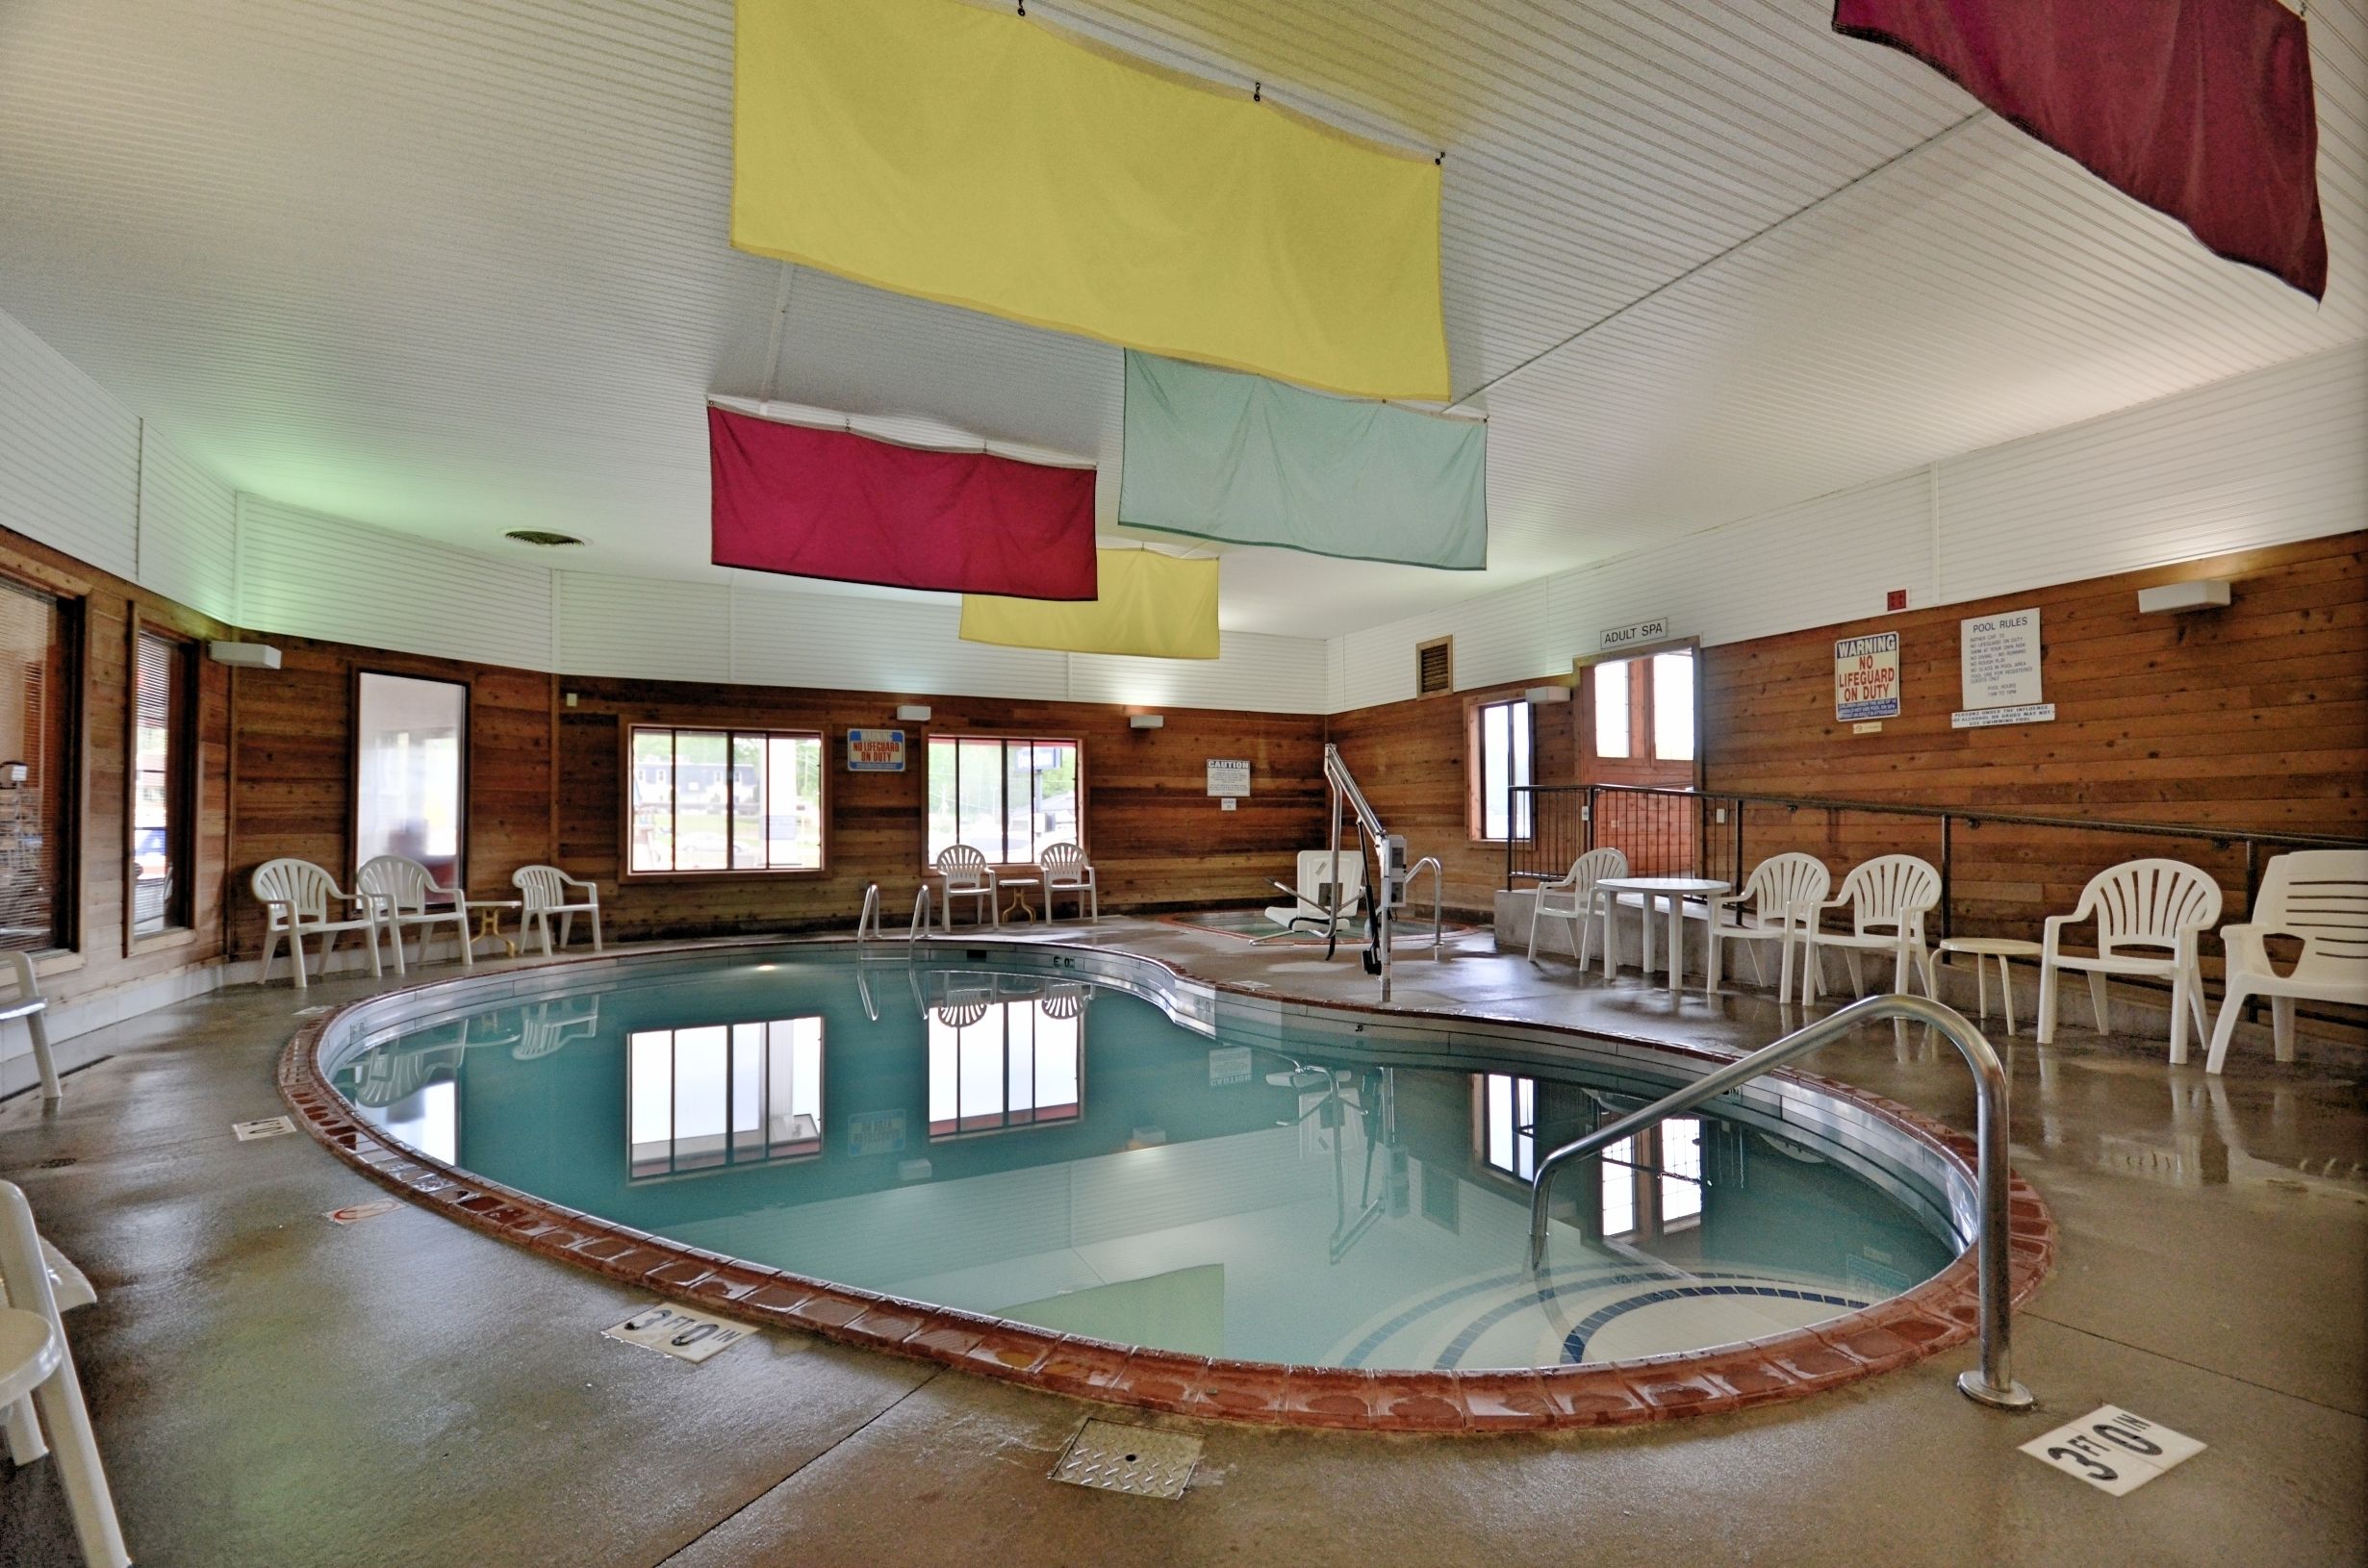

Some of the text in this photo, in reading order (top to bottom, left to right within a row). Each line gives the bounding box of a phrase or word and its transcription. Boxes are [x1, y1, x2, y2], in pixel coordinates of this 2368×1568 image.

[1604, 622, 1663, 644] ADULT SPA
[1973, 617, 2028, 633] POOL RULES
[1839, 635, 1896, 658] WARNING
[1859, 655, 1873, 670] NO
[1839, 668, 1895, 688] LIFEGUARD
[1844, 684, 1890, 702] ON DUTY
[853, 742, 900, 752] NO LIFEGUARD
[861, 751, 892, 762] ON DUTY
[1208, 760, 1249, 770] CAUTION
[624, 1309, 743, 1347] 3 FT 0 IN
[2048, 1413, 2163, 1482] 3 FT 0 IN
